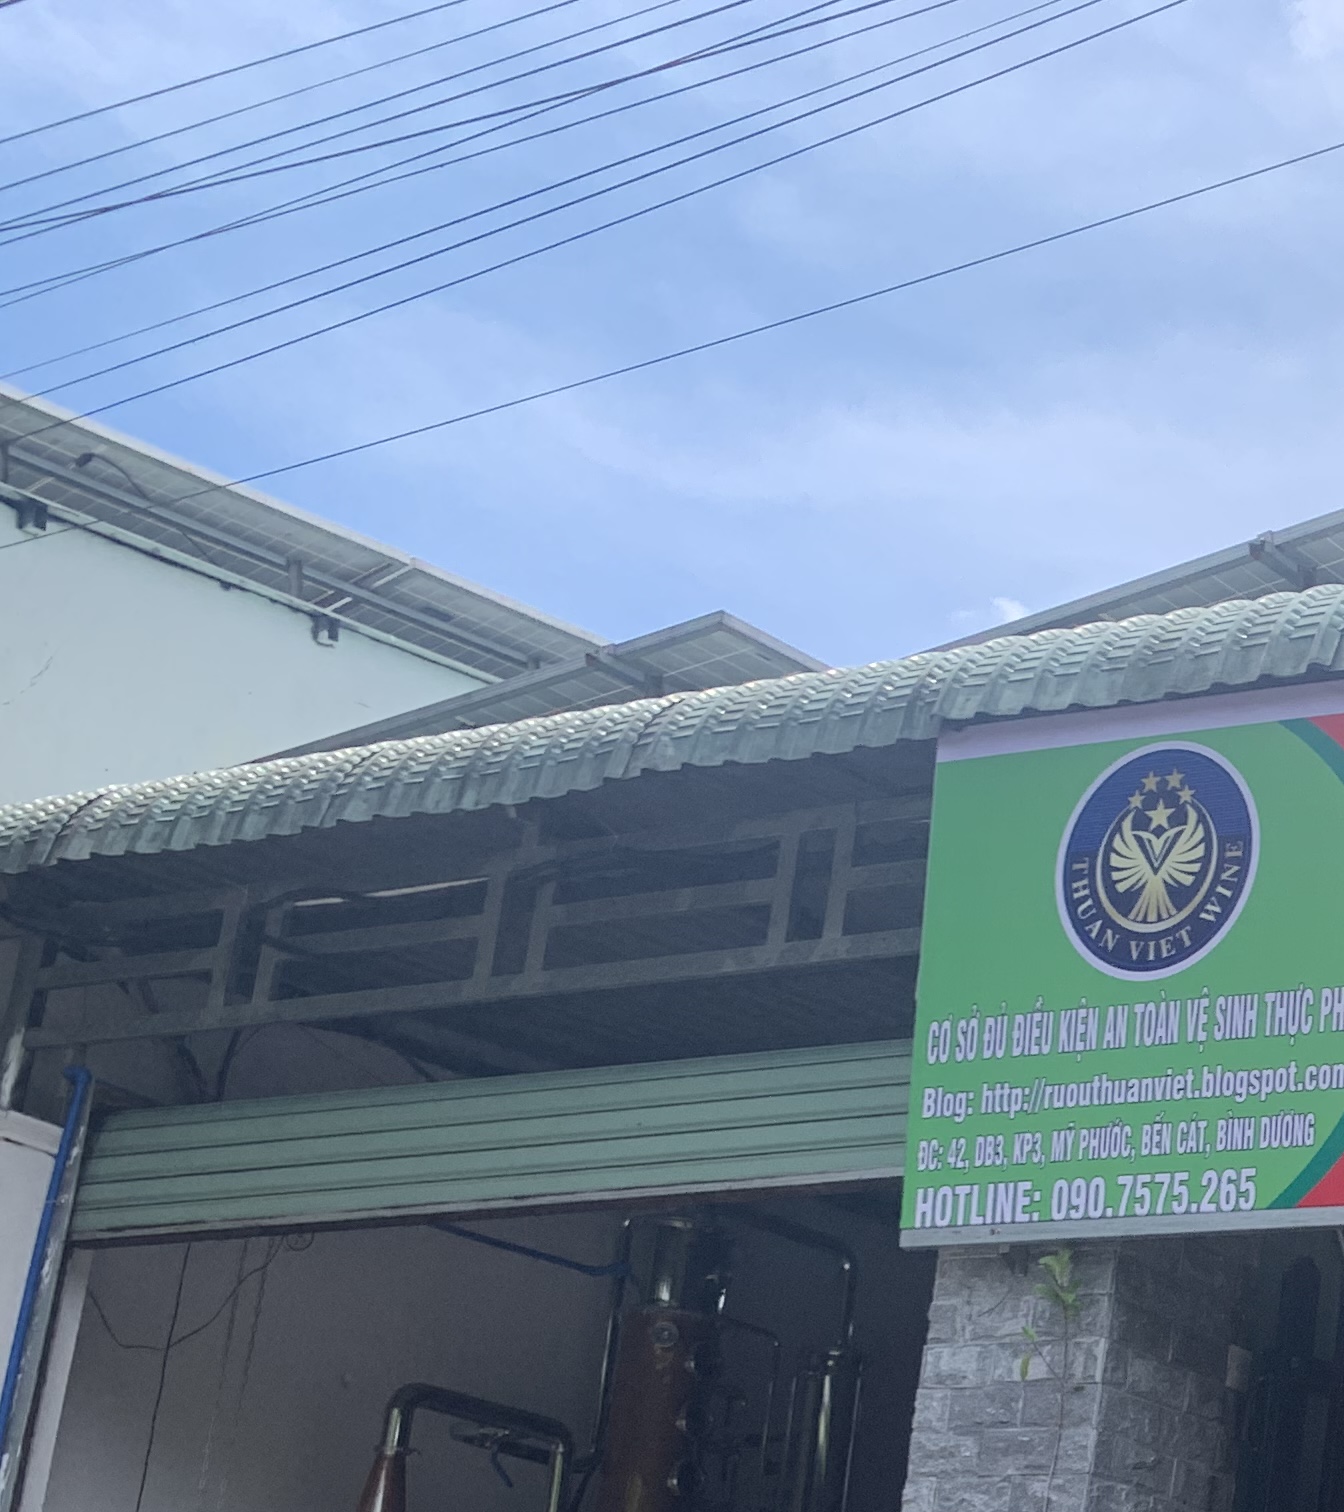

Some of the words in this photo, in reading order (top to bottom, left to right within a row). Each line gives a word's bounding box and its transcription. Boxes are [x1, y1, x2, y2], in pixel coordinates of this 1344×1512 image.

[1071, 856, 1121, 953] THUAN
[1128, 926, 1193, 962] VIET
[1198, 840, 1245, 924] WINE
[926, 1012, 953, 1065] CƠ
[954, 1003, 981, 1062] SỞ
[981, 1001, 1009, 1060] ĐỦ
[1010, 995, 1055, 1058] ĐIỀU
[1057, 996, 1100, 1063] KIỆN
[1102, 1004, 1129, 1050] AN
[1133, 989, 1181, 1047] TOÀN
[1186, 986, 1210, 1053] VỆ
[1213, 993, 1259, 1042] SINH
[1263, 983, 1315, 1046] THỰC
[921, 1086, 975, 1124] Blog:
[916, 1139, 943, 1172] ĐC:
[946, 1138, 970, 1175] 42,
[974, 1134, 1008, 1171] DB3,
[1012, 1131, 1046, 1169] KP3,
[1050, 1121, 1076, 1163] MỸ
[1078, 1116, 1136, 1163] PHƯỚC,
[1140, 1110, 1173, 1157] BẾN
[1175, 1112, 1211, 1159] CÁT,
[1215, 1109, 1256, 1152] BÌNH
[1259, 1109, 1316, 1150] DƯƠNG
[914, 1179, 1042, 1229] HOTLINE:
[1050, 1167, 1257, 1221] 090.7575.265
